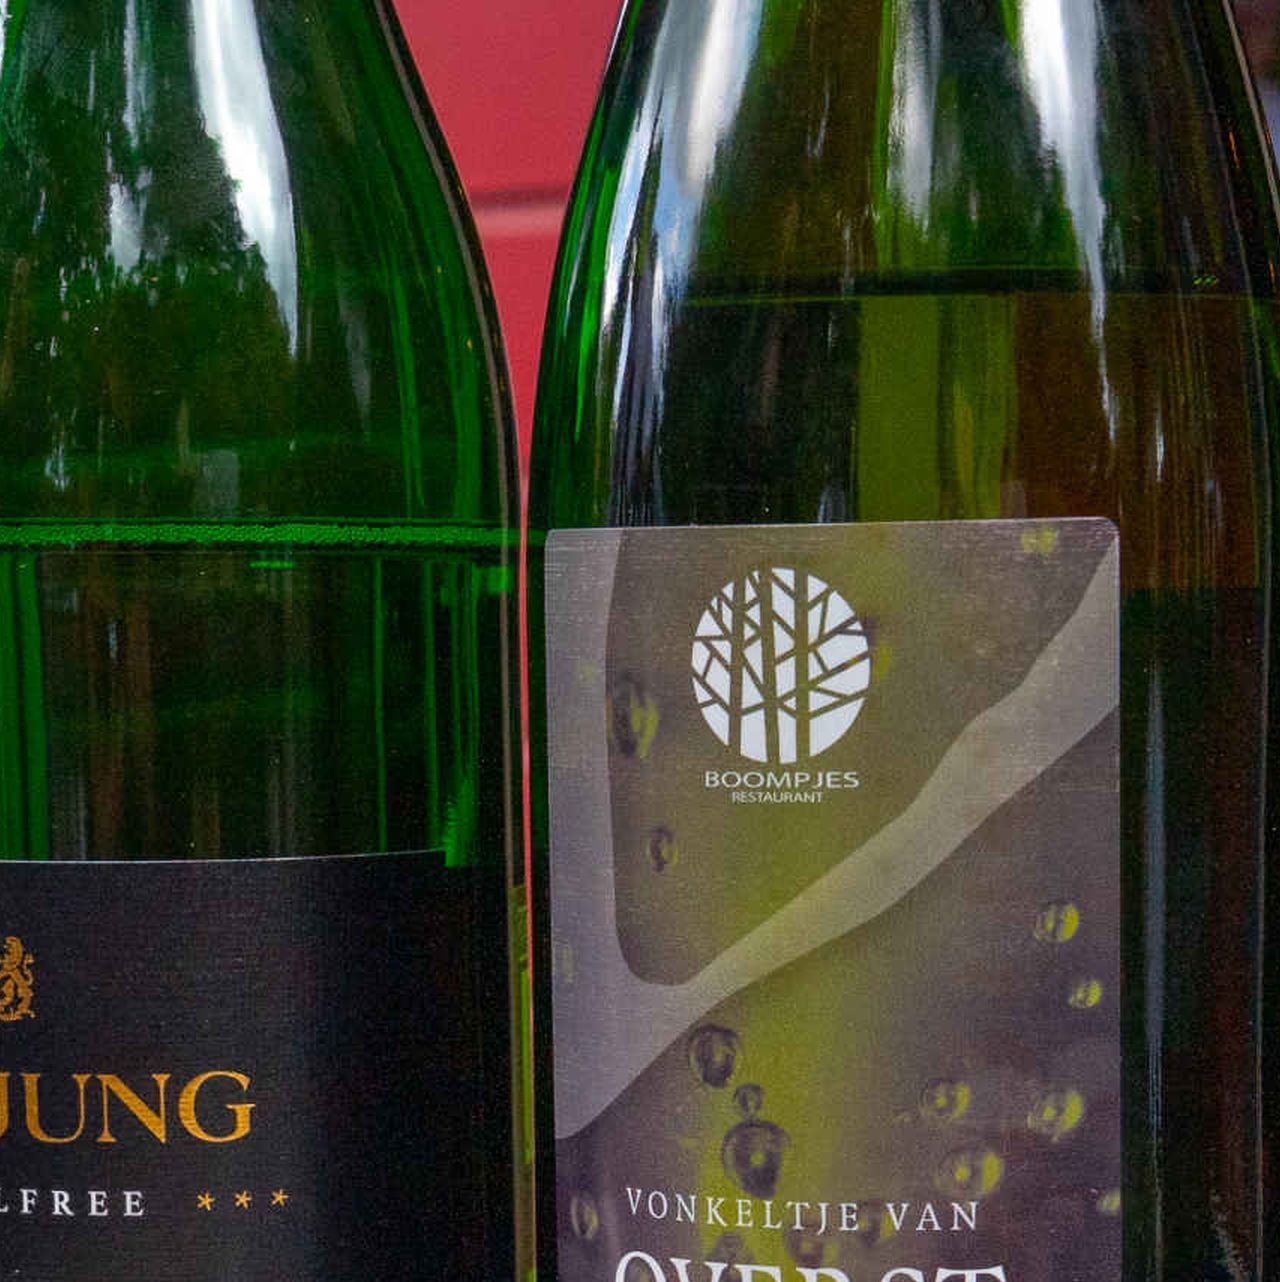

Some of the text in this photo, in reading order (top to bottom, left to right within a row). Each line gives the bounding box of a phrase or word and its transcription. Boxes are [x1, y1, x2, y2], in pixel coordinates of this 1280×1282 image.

[704, 770, 860, 790] BOOMPJES
[731, 791, 824, 804] RESTAURANT
[626, 1187, 979, 1236] VONKELTJE VAN
